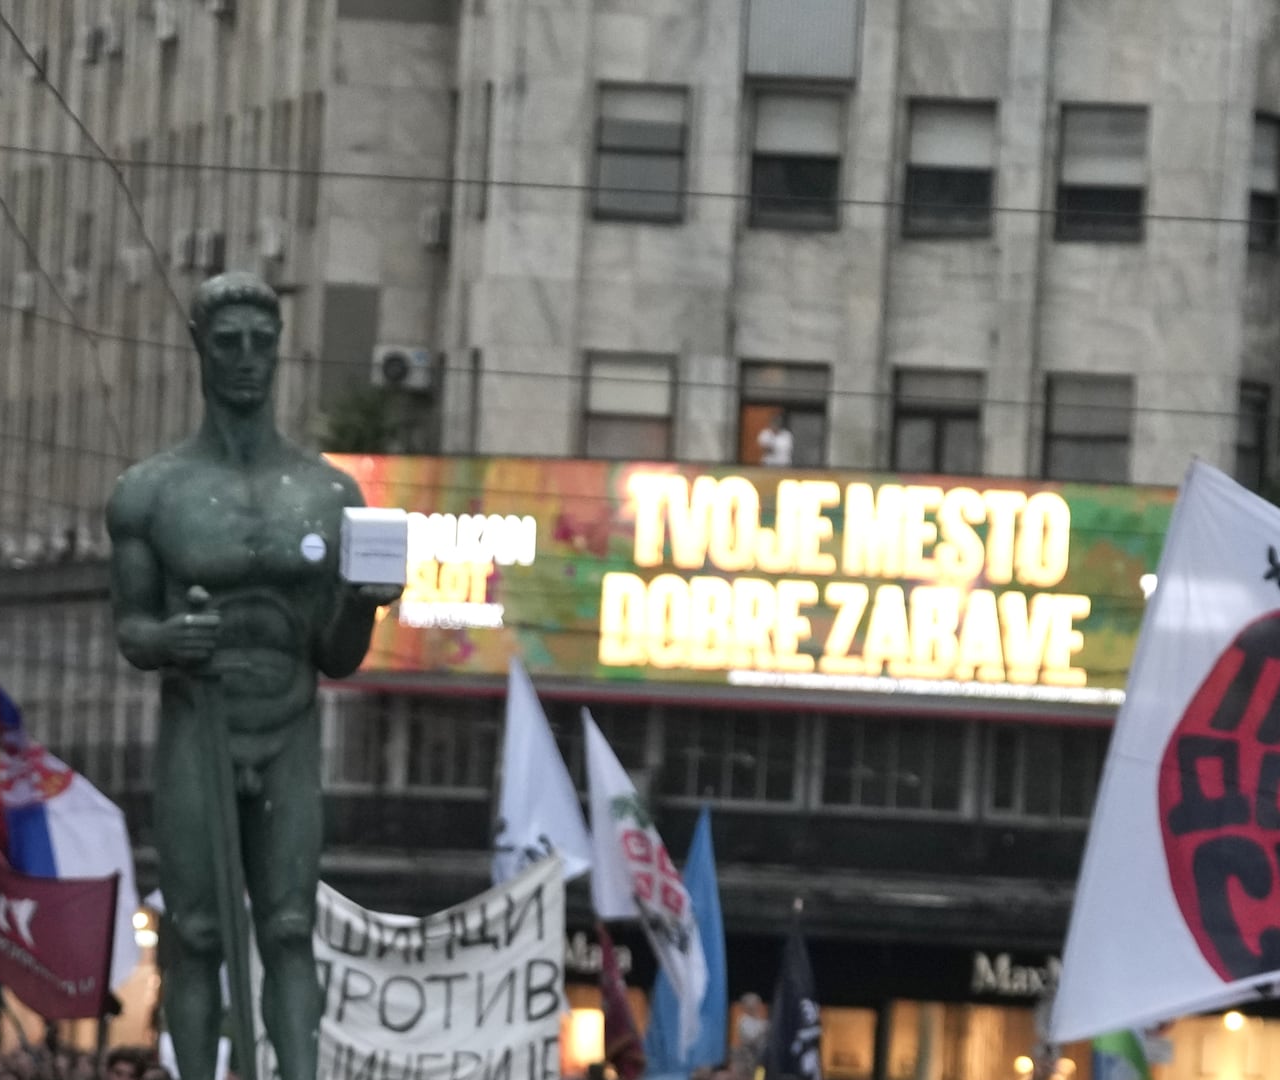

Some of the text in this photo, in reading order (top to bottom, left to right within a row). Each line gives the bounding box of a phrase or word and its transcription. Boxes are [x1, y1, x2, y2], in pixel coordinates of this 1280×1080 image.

[627, 472, 1072, 588] TVOJE MESTO
[598, 571, 1092, 688] DOBRE ZABAVE
